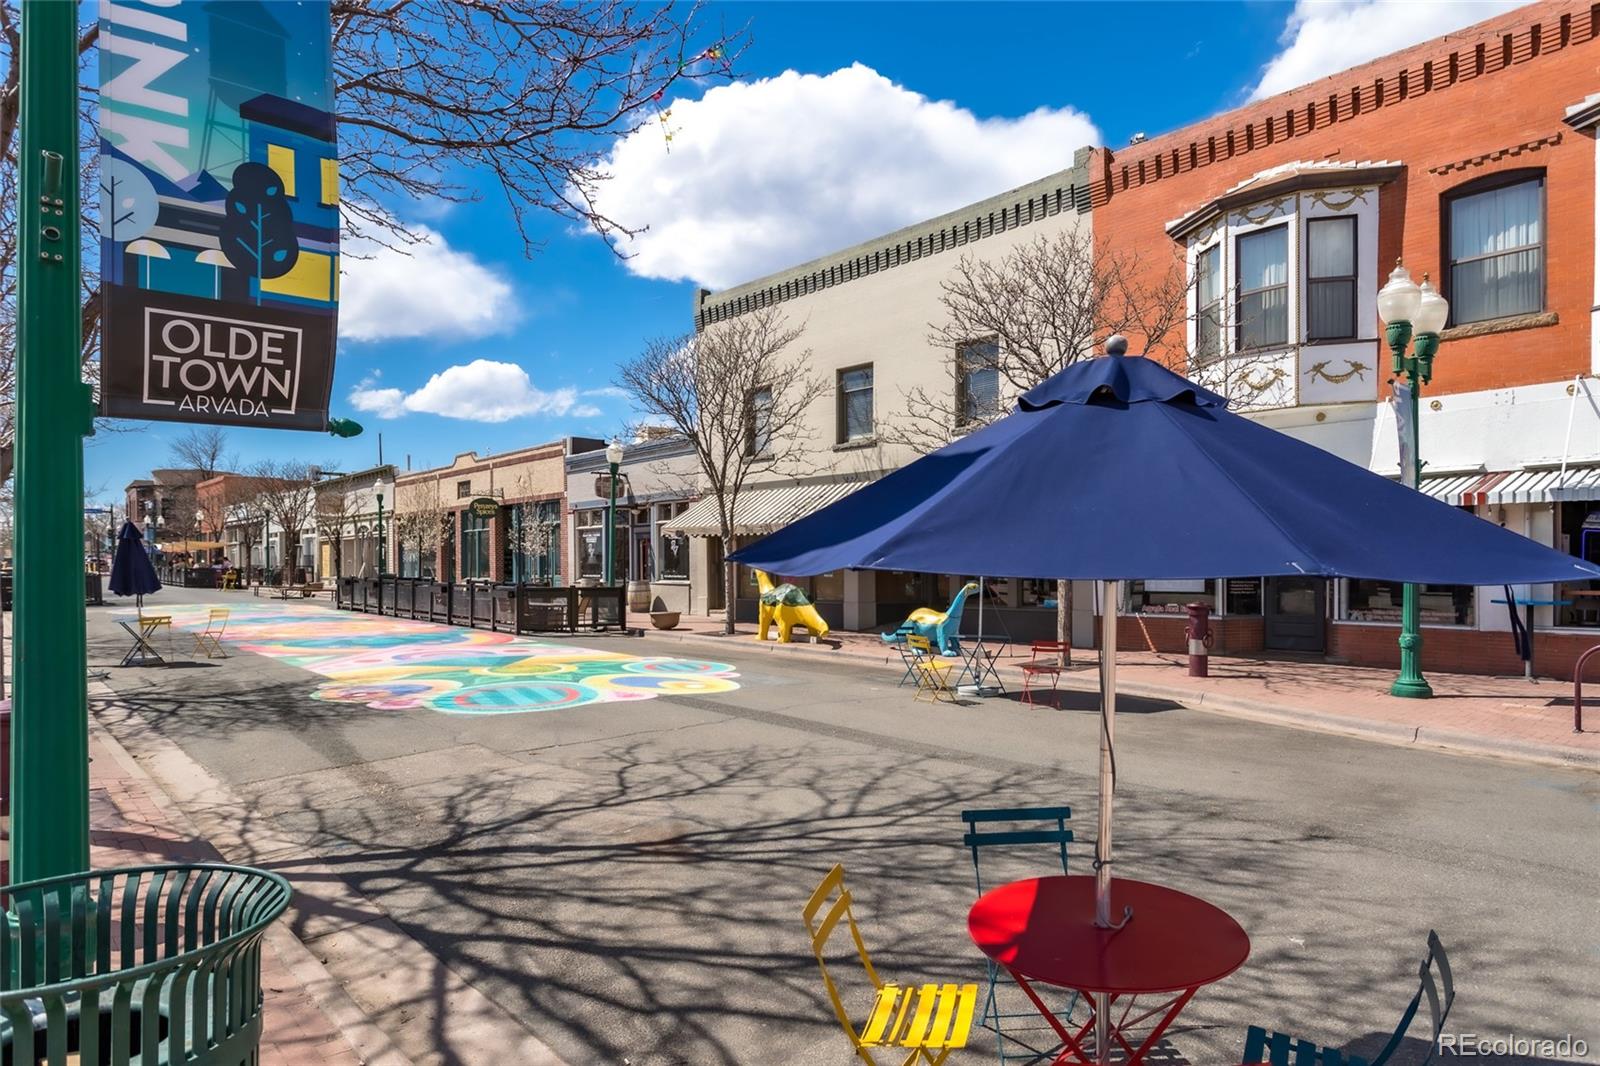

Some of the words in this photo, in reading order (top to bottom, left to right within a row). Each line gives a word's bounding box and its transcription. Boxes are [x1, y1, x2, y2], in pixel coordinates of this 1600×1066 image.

[98, 0, 190, 182] INK
[162, 319, 285, 366] OLDE
[152, 354, 291, 399] TOWN
[178, 394, 269, 418] ARVADA
